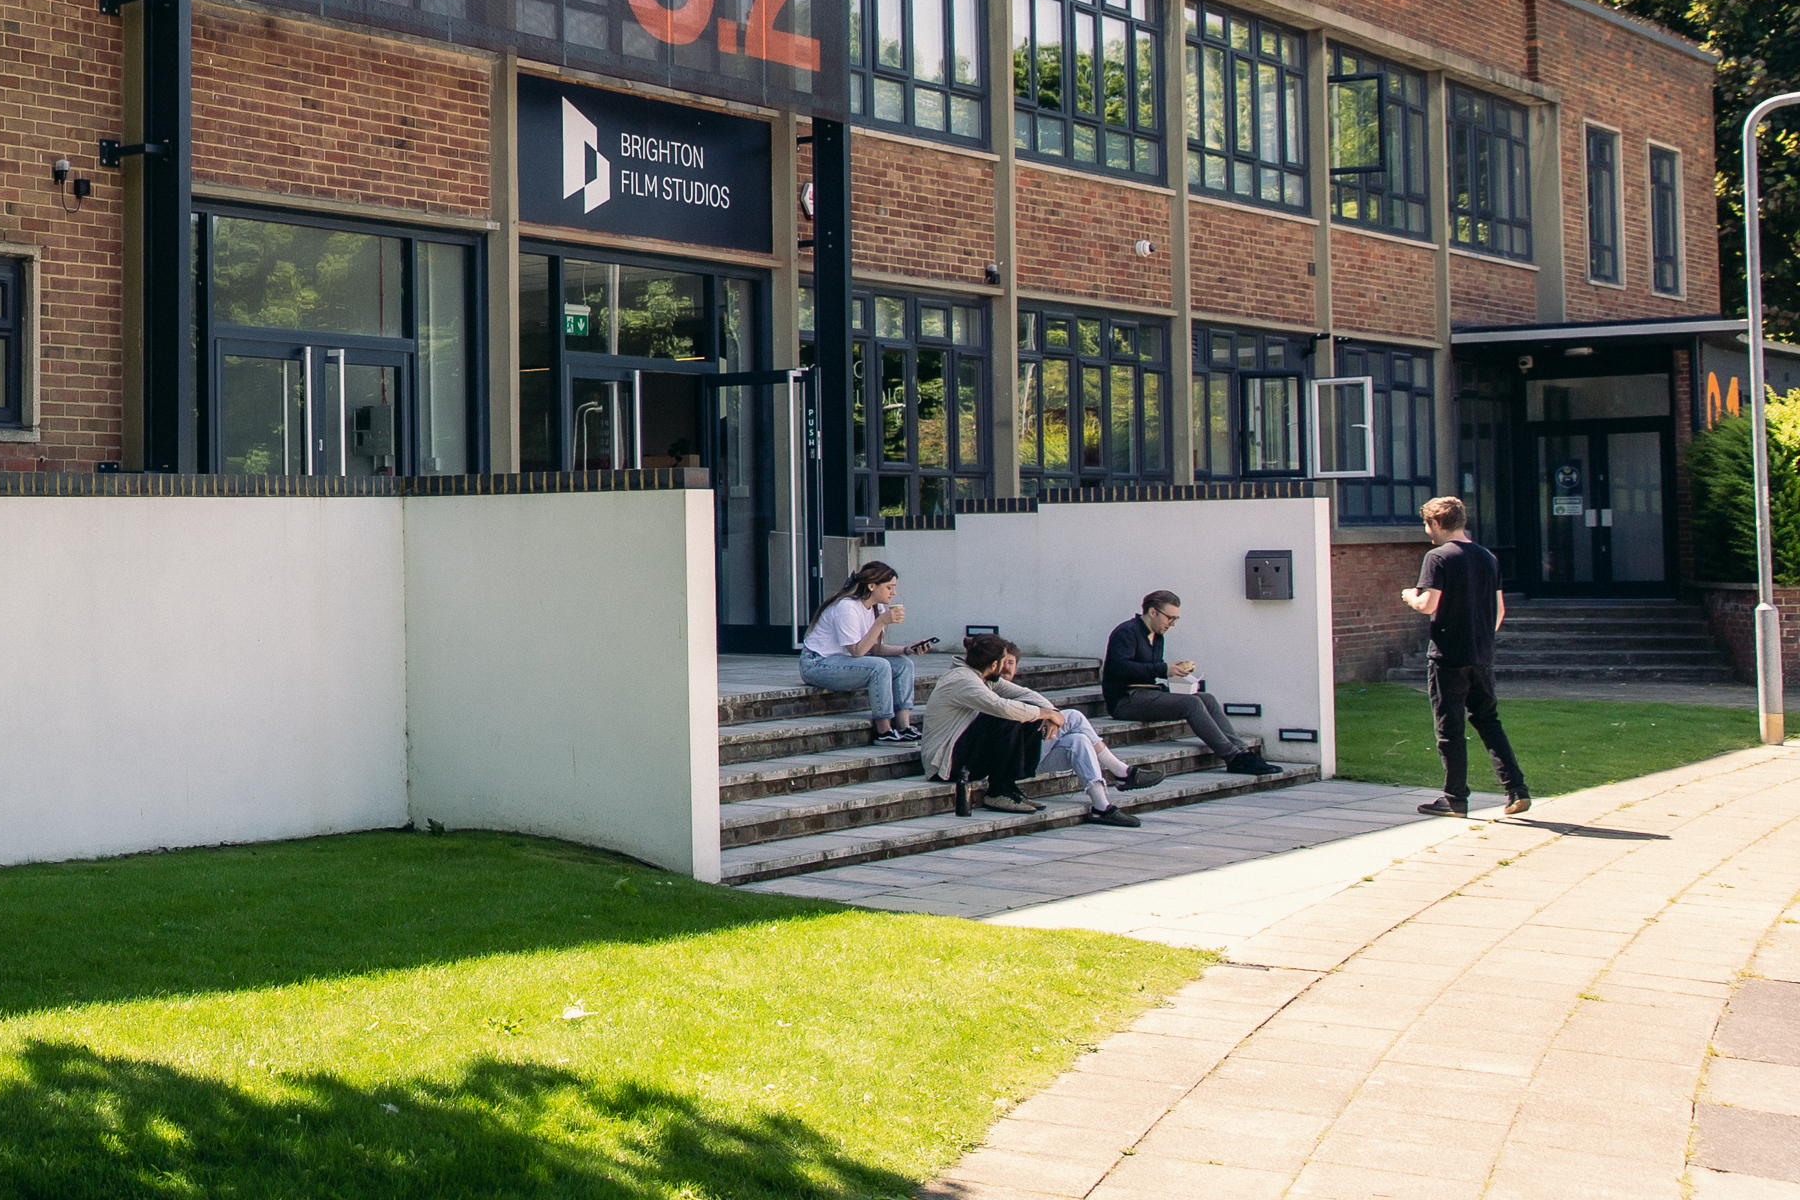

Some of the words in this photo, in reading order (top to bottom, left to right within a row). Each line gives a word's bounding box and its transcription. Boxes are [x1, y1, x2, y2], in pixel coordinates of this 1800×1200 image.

[620, 132, 704, 170] BRIGHTON
[620, 169, 658, 199] FILM
[662, 176, 731, 210] STUDIOS
